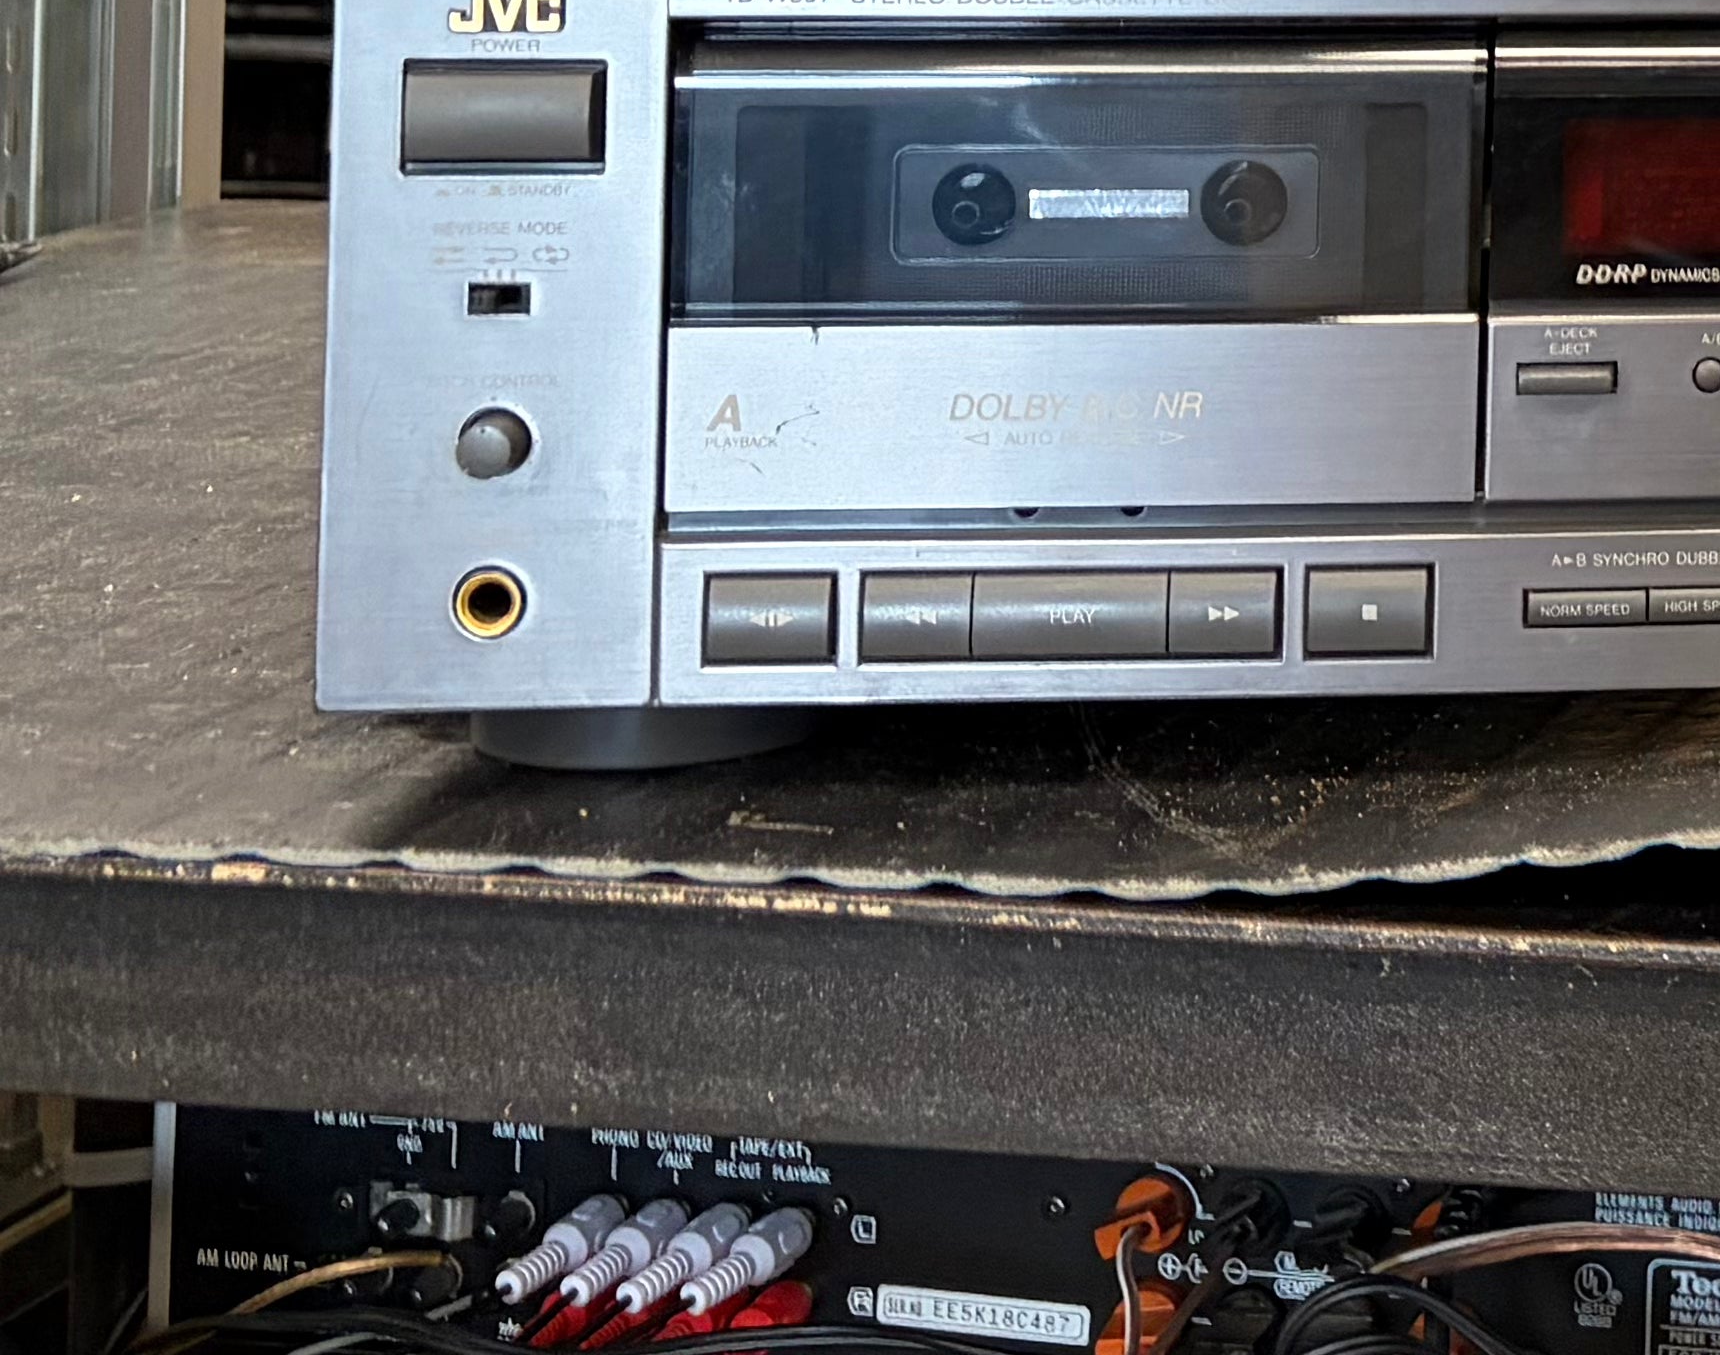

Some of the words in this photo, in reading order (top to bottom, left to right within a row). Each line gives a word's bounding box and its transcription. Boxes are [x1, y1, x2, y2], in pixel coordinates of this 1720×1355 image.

[471, 38, 541, 53] POWER
[508, 183, 571, 196] STANDBY
[518, 221, 569, 236] MODE
[1650, 267, 1720, 283] DYNAMICS
[1544, 327, 1598, 339] A-DECK
[1549, 342, 1591, 355] EJECT
[706, 394, 742, 432] A
[949, 392, 1069, 421] DOLBY
[1153, 392, 1204, 419] NR
[704, 436, 778, 449] PLAYBACK
[1004, 430, 1053, 446] AUTO
[1593, 551, 1670, 567] SYNCHRO
[1540, 603, 1581, 618] NORM
[1585, 603, 1630, 617] SPEED
[1664, 599, 1698, 613] HIGH
[1049, 606, 1095, 626] PLAY
[493, 1121, 515, 1139] AM
[517, 1122, 544, 1141] ANT
[591, 1128, 639, 1148] PHONO
[1595, 1205, 1671, 1227] PUISSANCE
[197, 1248, 219, 1267] AM
[224, 1249, 259, 1272] LOOP
[263, 1253, 289, 1275] ANT
[1574, 1300, 1617, 1316] LISTED
[933, 1300, 1070, 1333] EE5K18C487
[1670, 1310, 1720, 1327] FM/AM
